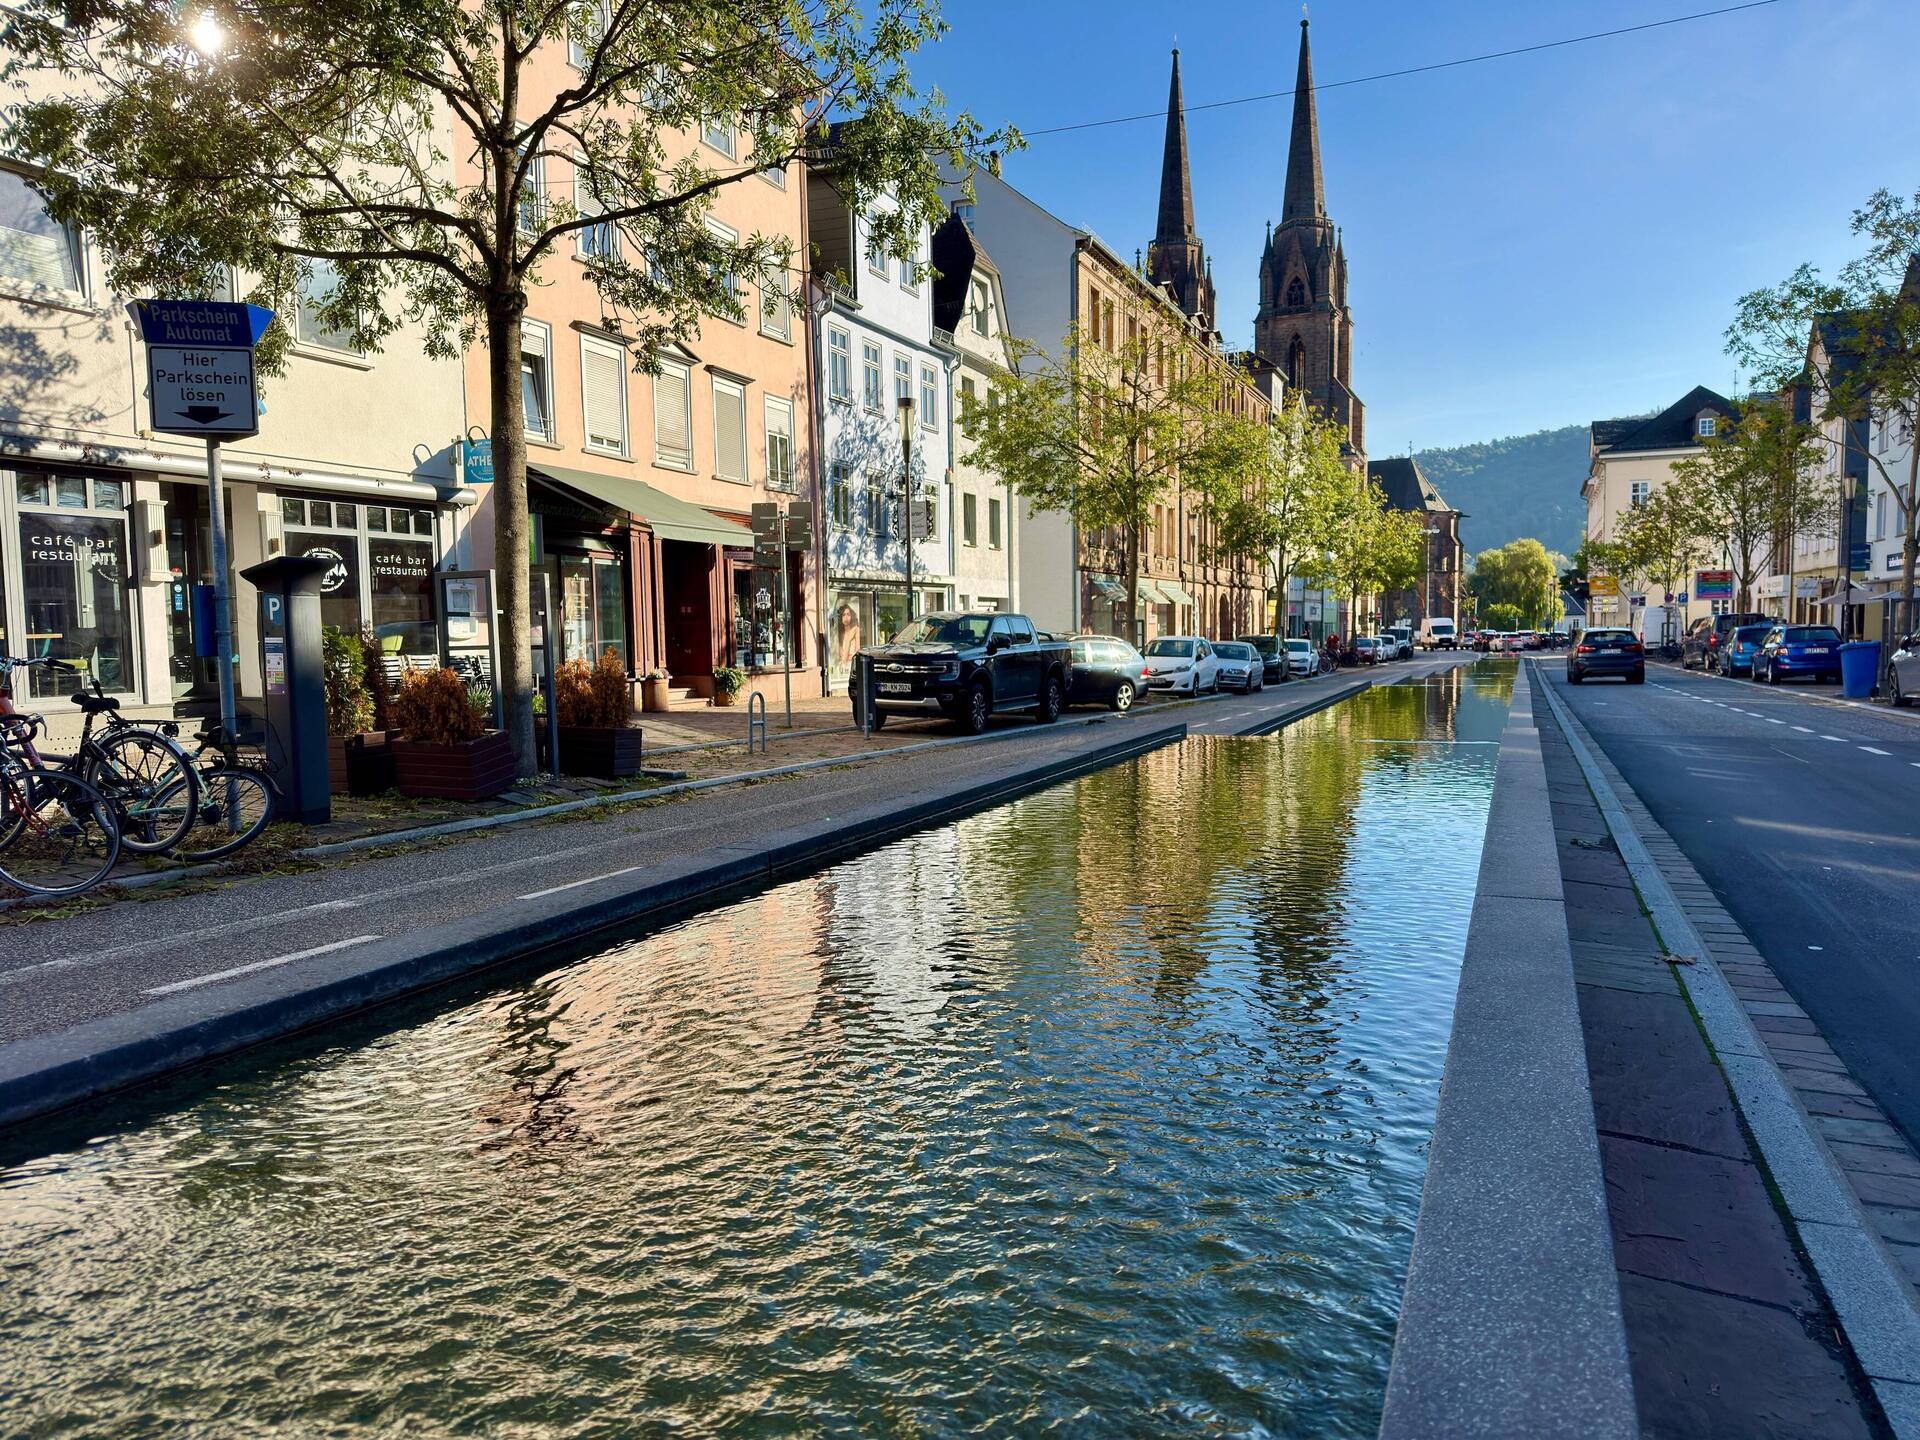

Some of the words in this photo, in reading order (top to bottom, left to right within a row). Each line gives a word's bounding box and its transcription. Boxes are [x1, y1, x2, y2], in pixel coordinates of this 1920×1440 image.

[150, 304, 239, 325] Parkschein
[166, 323, 232, 341] Automat
[183, 352, 218, 367] Hier
[156, 369, 248, 385] Parkschein
[180, 387, 225, 402] lösen
[467, 455, 493, 468] ATHE
[31, 535, 74, 546] café
[84, 536, 114, 549] bar
[31, 549, 117, 562] restaurant
[376, 554, 402, 564] café
[407, 556, 426, 565] bar
[376, 566, 428, 577] restaurant
[268, 597, 281, 621] P
